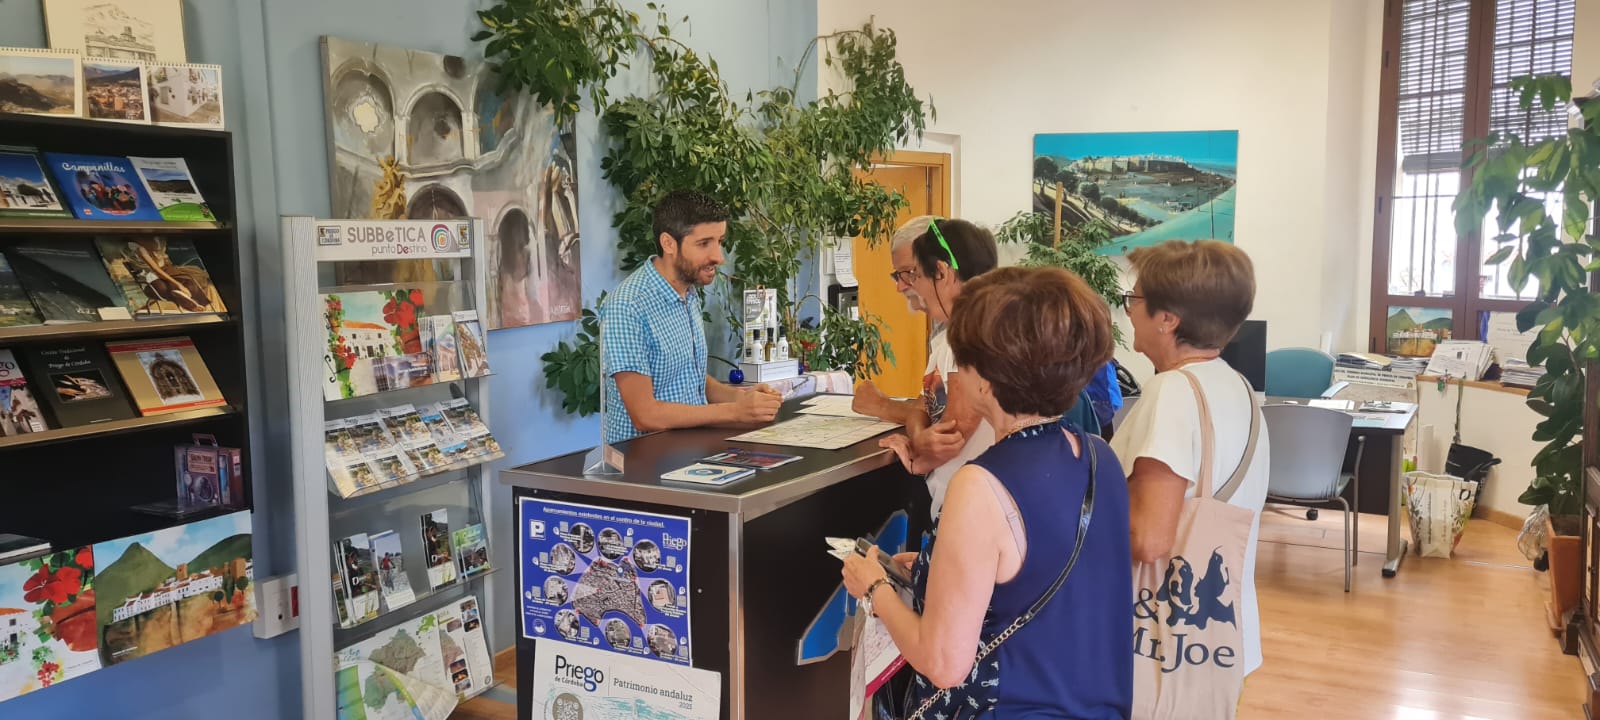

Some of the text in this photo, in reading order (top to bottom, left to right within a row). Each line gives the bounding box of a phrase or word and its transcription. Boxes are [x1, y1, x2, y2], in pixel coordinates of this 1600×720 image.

[62, 161, 126, 176] Campanillas
[530, 521, 545, 537] P
[555, 655, 604, 692] Priego
[613, 677, 693, 702] Patrimonio andaluz
